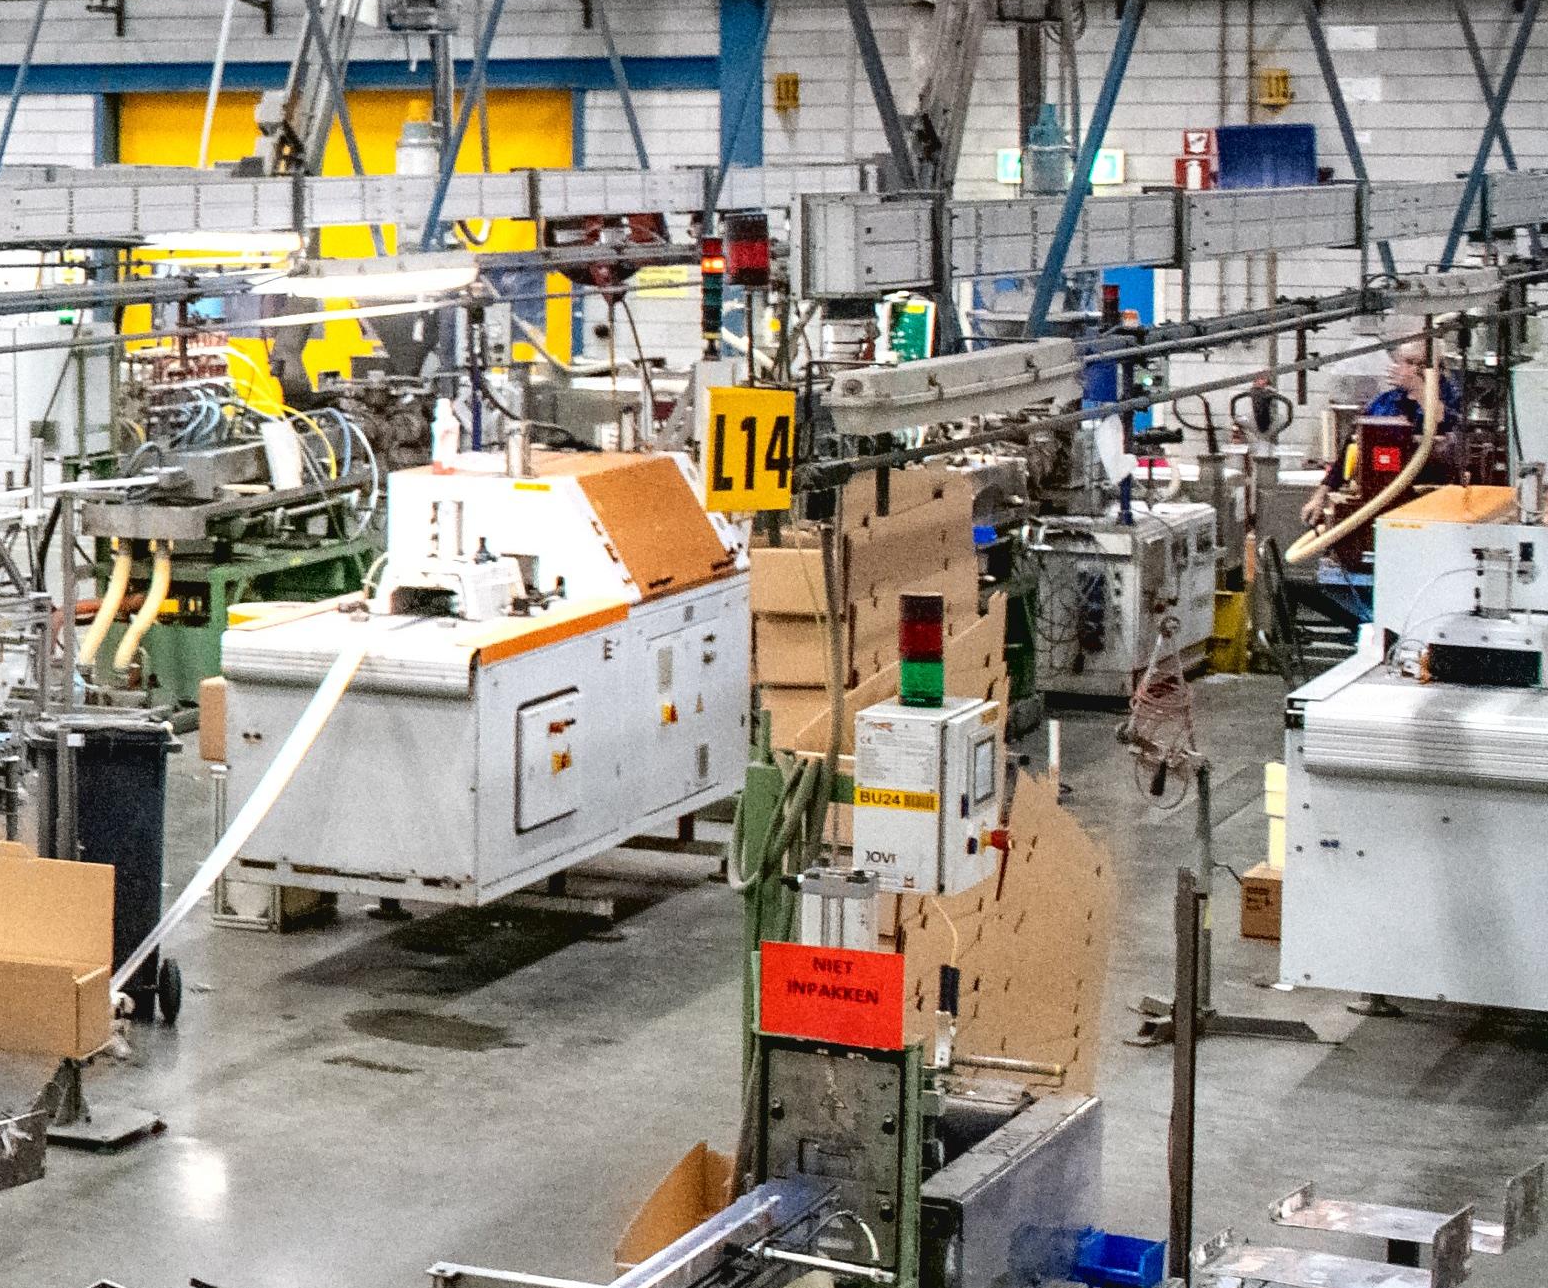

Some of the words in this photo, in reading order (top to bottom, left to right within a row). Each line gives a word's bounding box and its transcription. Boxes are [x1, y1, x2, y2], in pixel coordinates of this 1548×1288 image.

[711, 413, 793, 492] L14
[859, 790, 901, 806] BU24
[812, 956, 854, 975] NIET
[787, 978, 879, 1006] INPAKKEN
